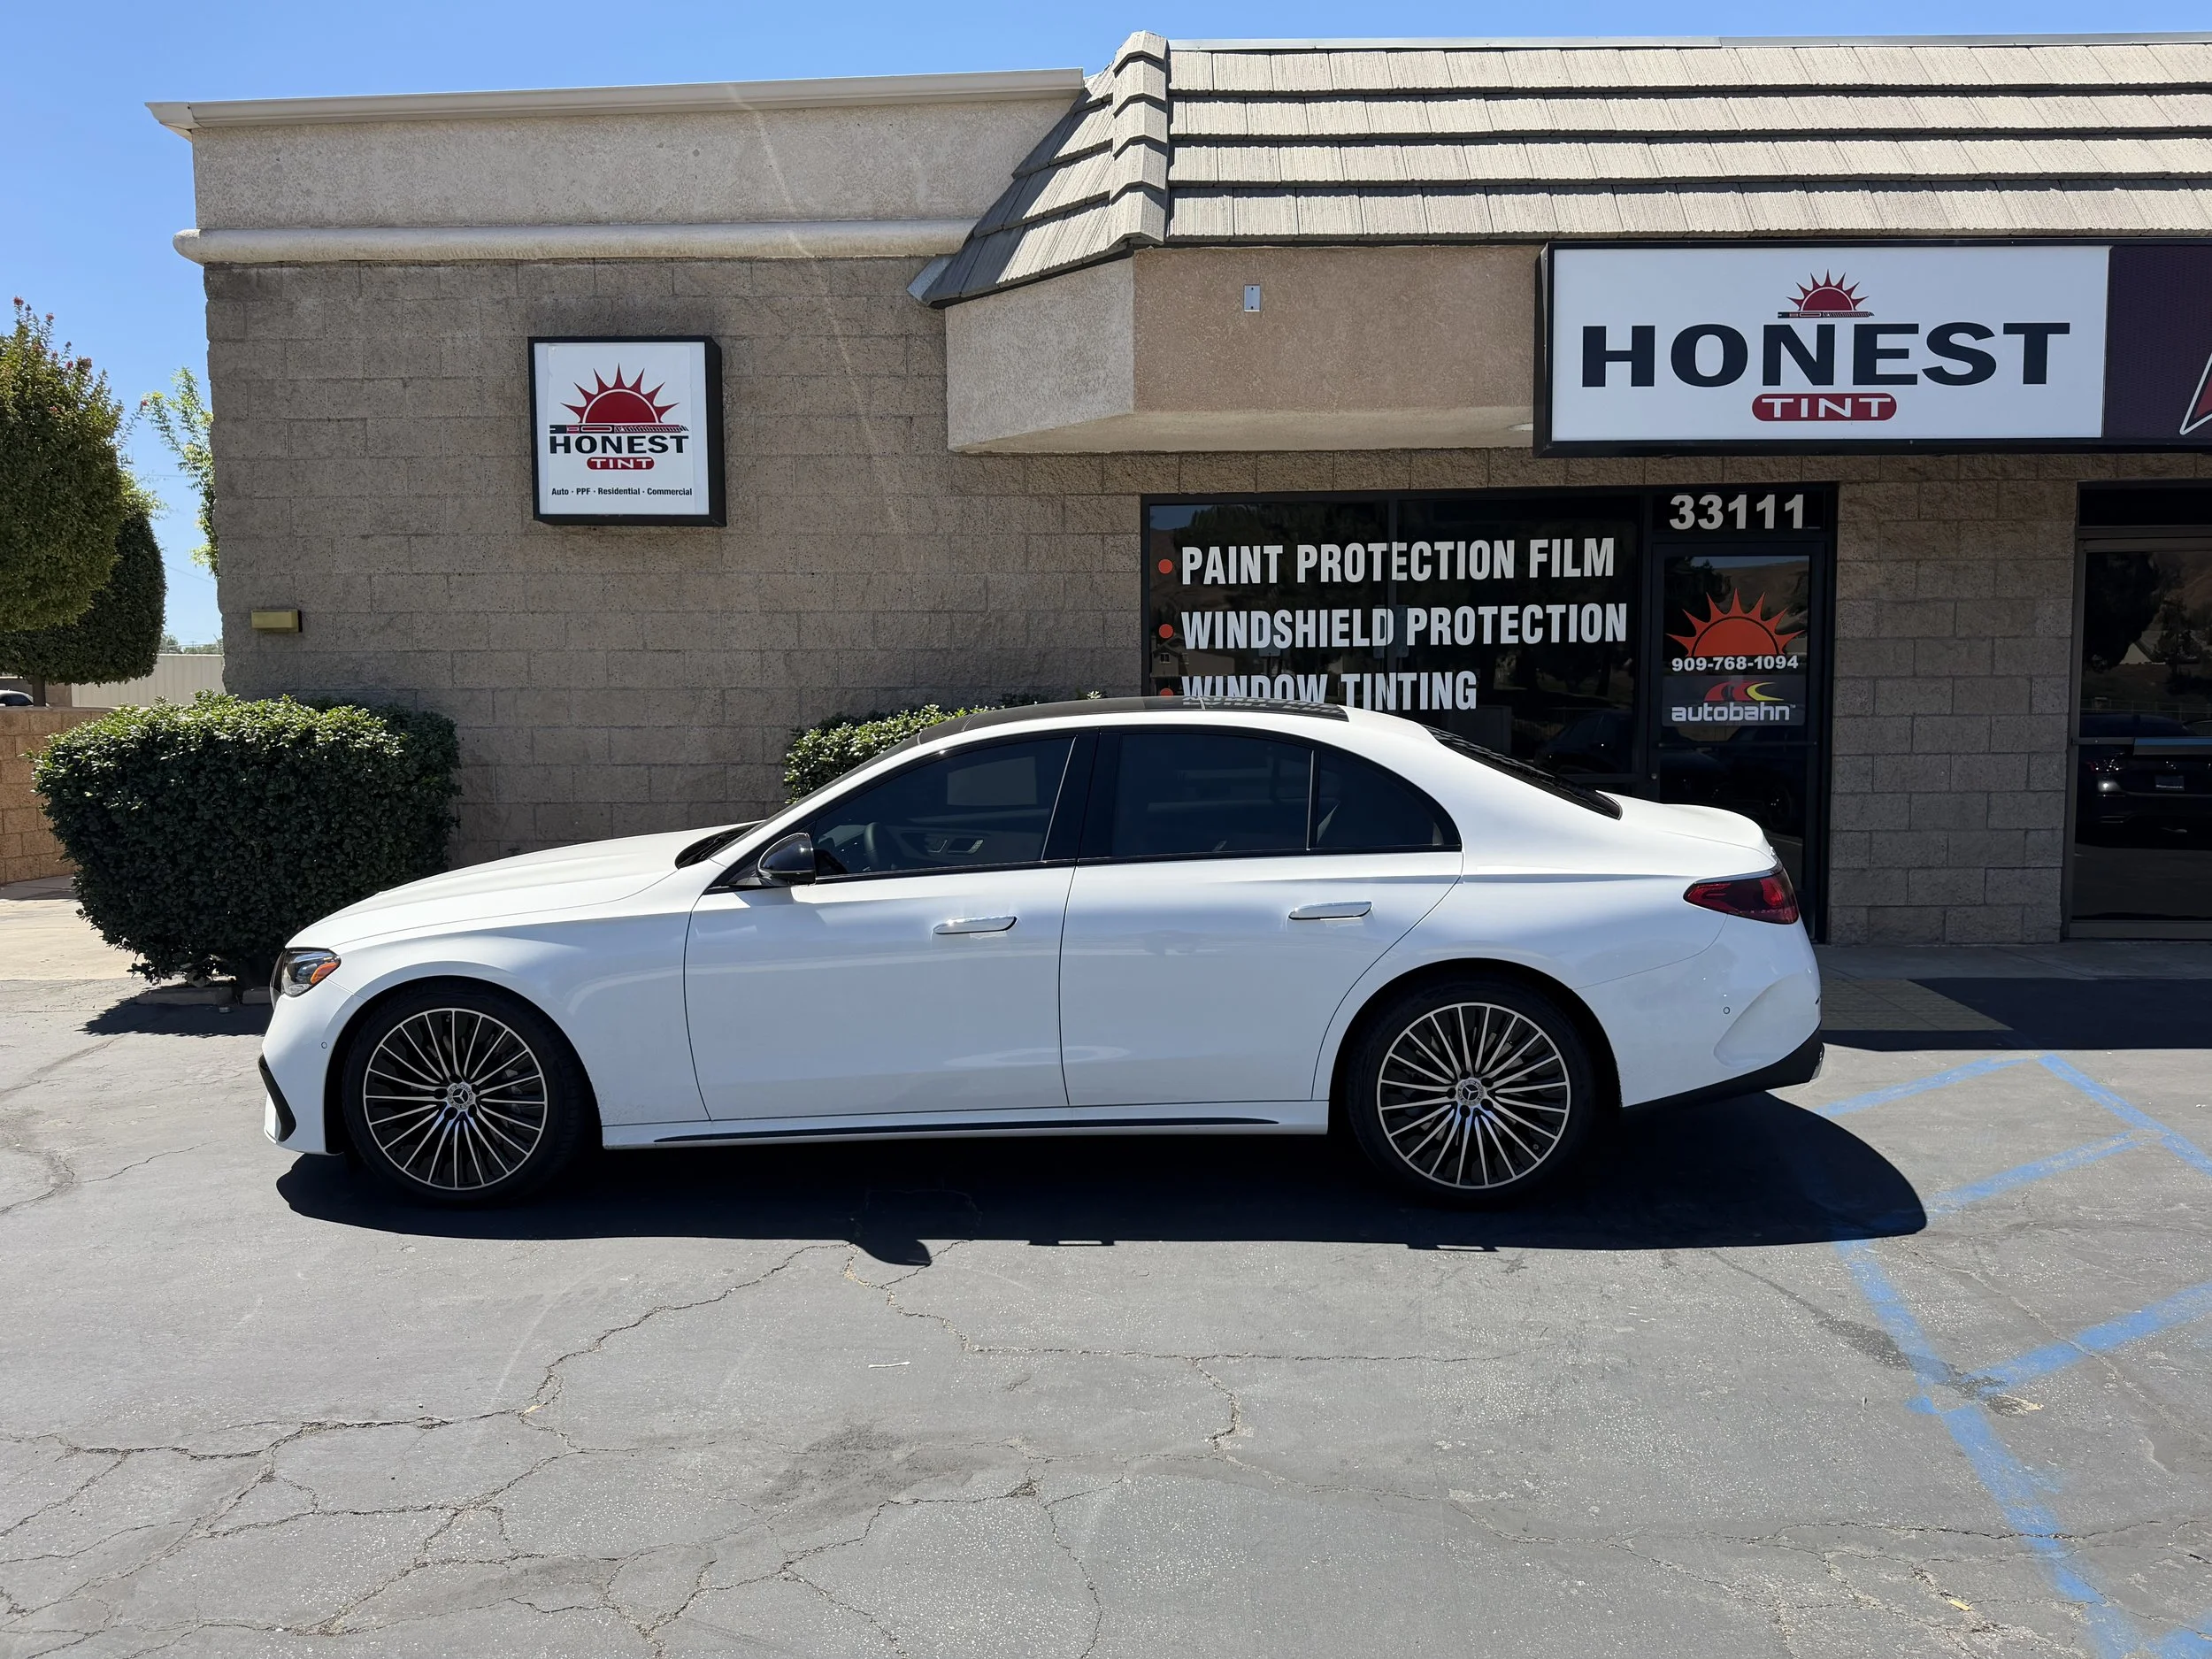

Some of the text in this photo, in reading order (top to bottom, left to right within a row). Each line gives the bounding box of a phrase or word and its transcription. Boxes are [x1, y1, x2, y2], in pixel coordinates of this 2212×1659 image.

[1581, 321, 2070, 388] HONEST
[1762, 397, 1893, 419] TINT
[549, 435, 689, 454] HONEST
[590, 458, 652, 469] TINT
[1669, 494, 1804, 530] 33111
[1181, 537, 1615, 585] PAINT PROTECTION FILM
[1181, 603, 1627, 649] WINDSHIELD PROTECTION
[1671, 656, 1799, 672] 909-768-1094
[1340, 671, 1477, 710] TINTING
[1671, 702, 1790, 721] autobahn
